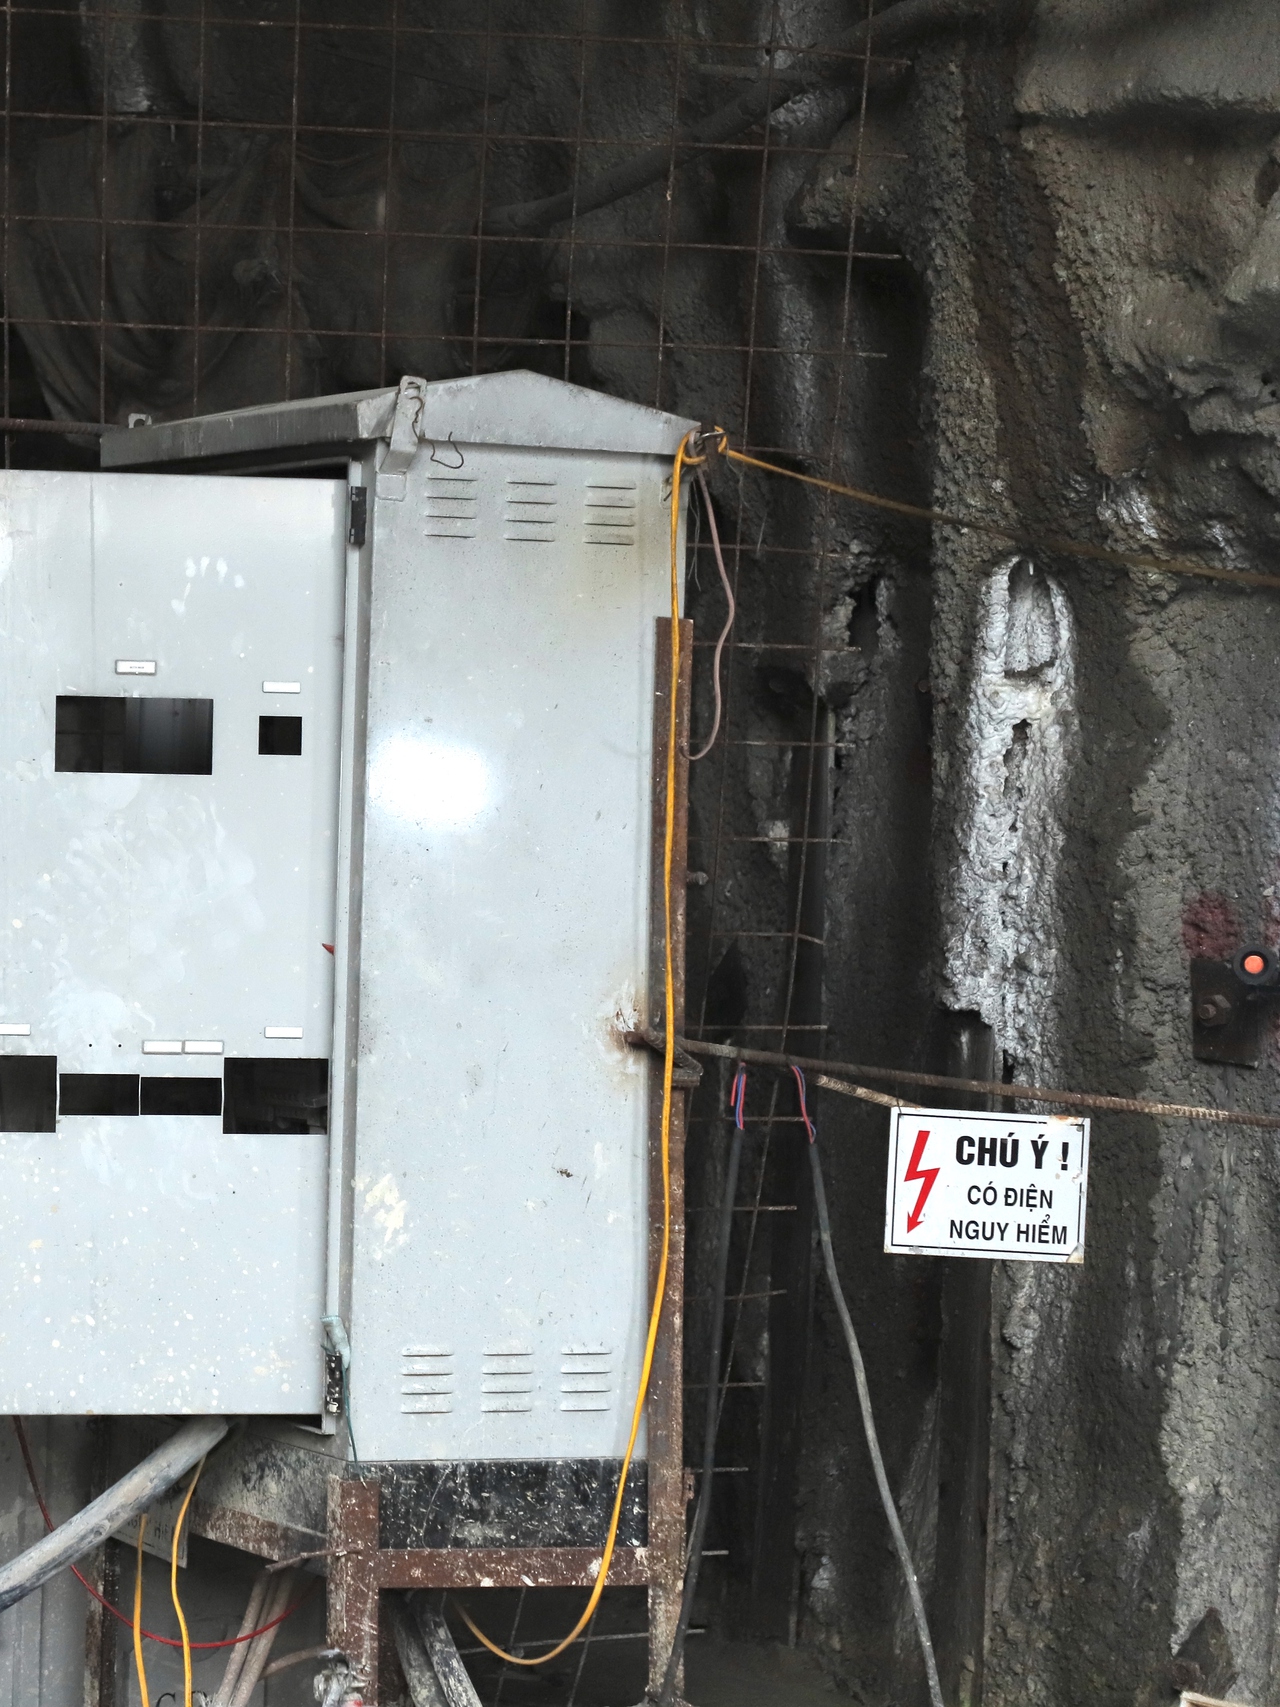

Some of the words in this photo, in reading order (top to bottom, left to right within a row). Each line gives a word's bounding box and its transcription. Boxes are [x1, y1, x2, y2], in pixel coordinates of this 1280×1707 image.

[955, 1132, 1020, 1168] CHÚ
[1030, 1134, 1049, 1170] Ý
[967, 1181, 998, 1206] CÓ
[1003, 1183, 1053, 1212] ĐIỆN
[949, 1219, 1009, 1242] NGUY
[1016, 1213, 1068, 1245] HIỂM
